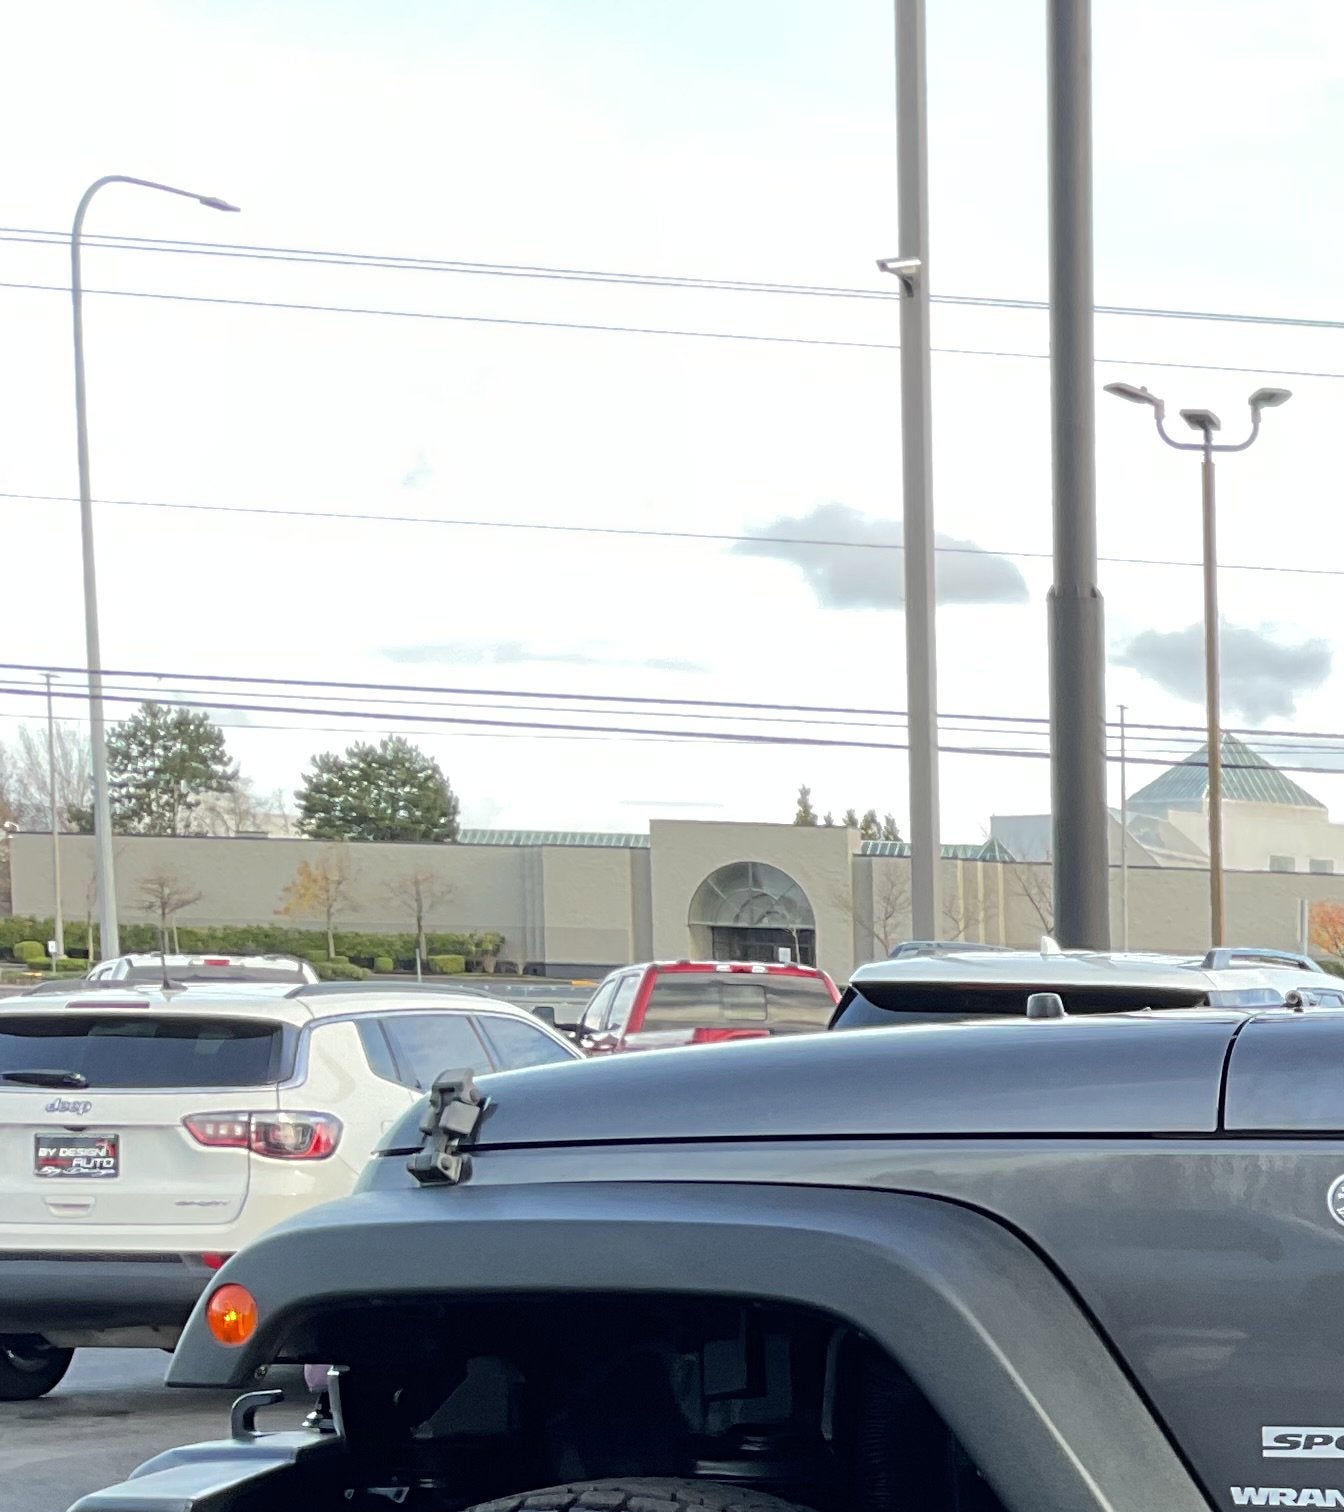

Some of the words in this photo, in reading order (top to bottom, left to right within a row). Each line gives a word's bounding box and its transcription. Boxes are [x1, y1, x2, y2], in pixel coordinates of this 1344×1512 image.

[38, 1147, 58, 1157] BY
[59, 1147, 107, 1157] DESIGN
[72, 1157, 115, 1168] AUTO
